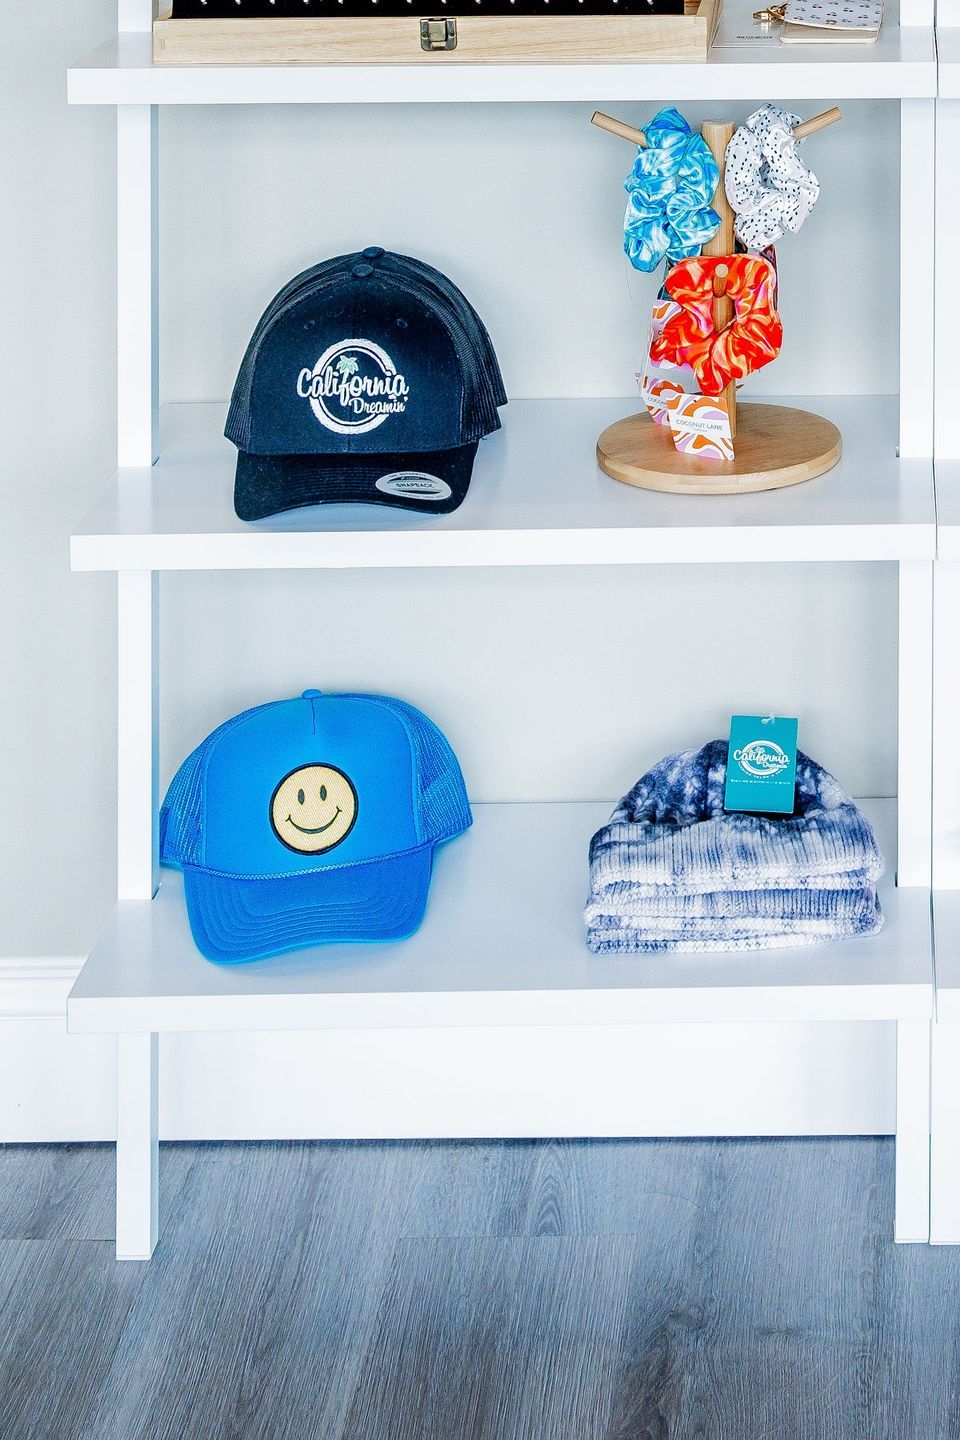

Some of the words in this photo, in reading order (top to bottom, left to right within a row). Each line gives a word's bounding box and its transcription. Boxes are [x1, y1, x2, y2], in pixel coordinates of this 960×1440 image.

[296, 365, 410, 407] California
[348, 395, 409, 414] Dreamin'
[676, 419, 705, 429] COCONUT
[706, 423, 723, 431] LANE
[733, 749, 791, 765] California
